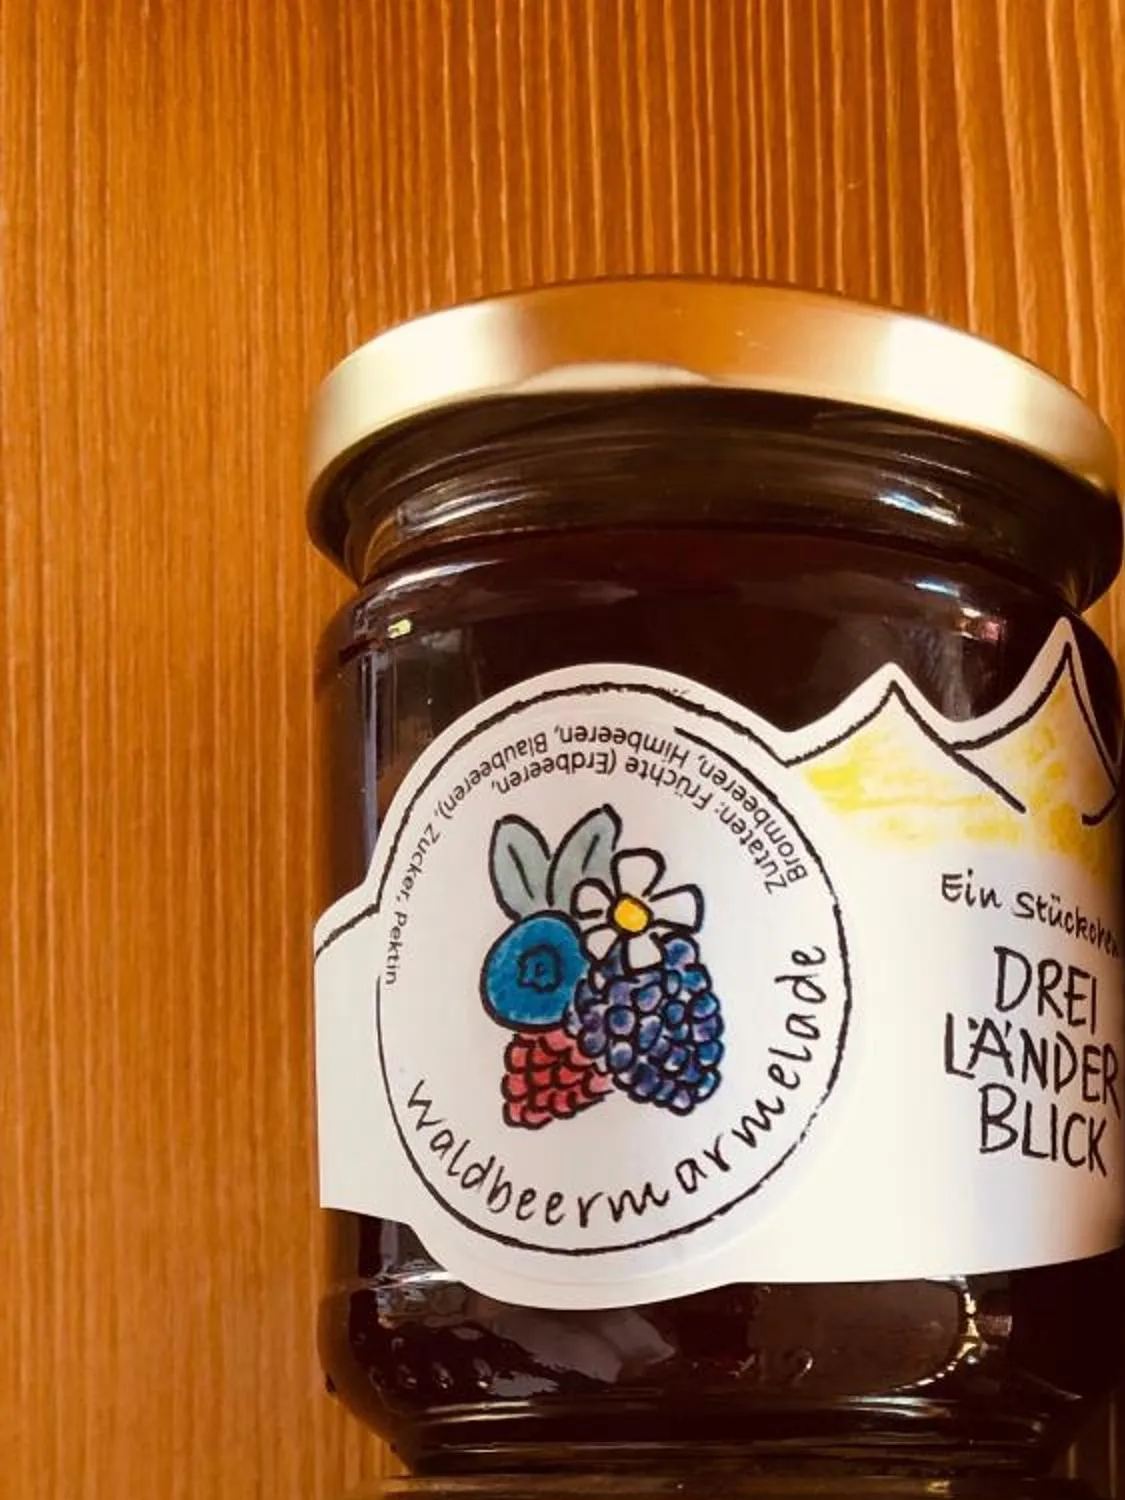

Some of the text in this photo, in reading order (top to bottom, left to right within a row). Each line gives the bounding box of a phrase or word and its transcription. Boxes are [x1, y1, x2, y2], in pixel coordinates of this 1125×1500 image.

[383, 724, 808, 986] Brombeeren, Himbeeren, Blaubeeren), Zucker, Pektin
[490, 750, 788, 894] Zutaten: Früchte (Erdbeeren,
[941, 868, 1001, 909] Ein
[993, 945, 1097, 1036] DREI
[944, 1012, 1121, 1120] LÄNDER
[978, 1082, 1107, 1178] BLICK
